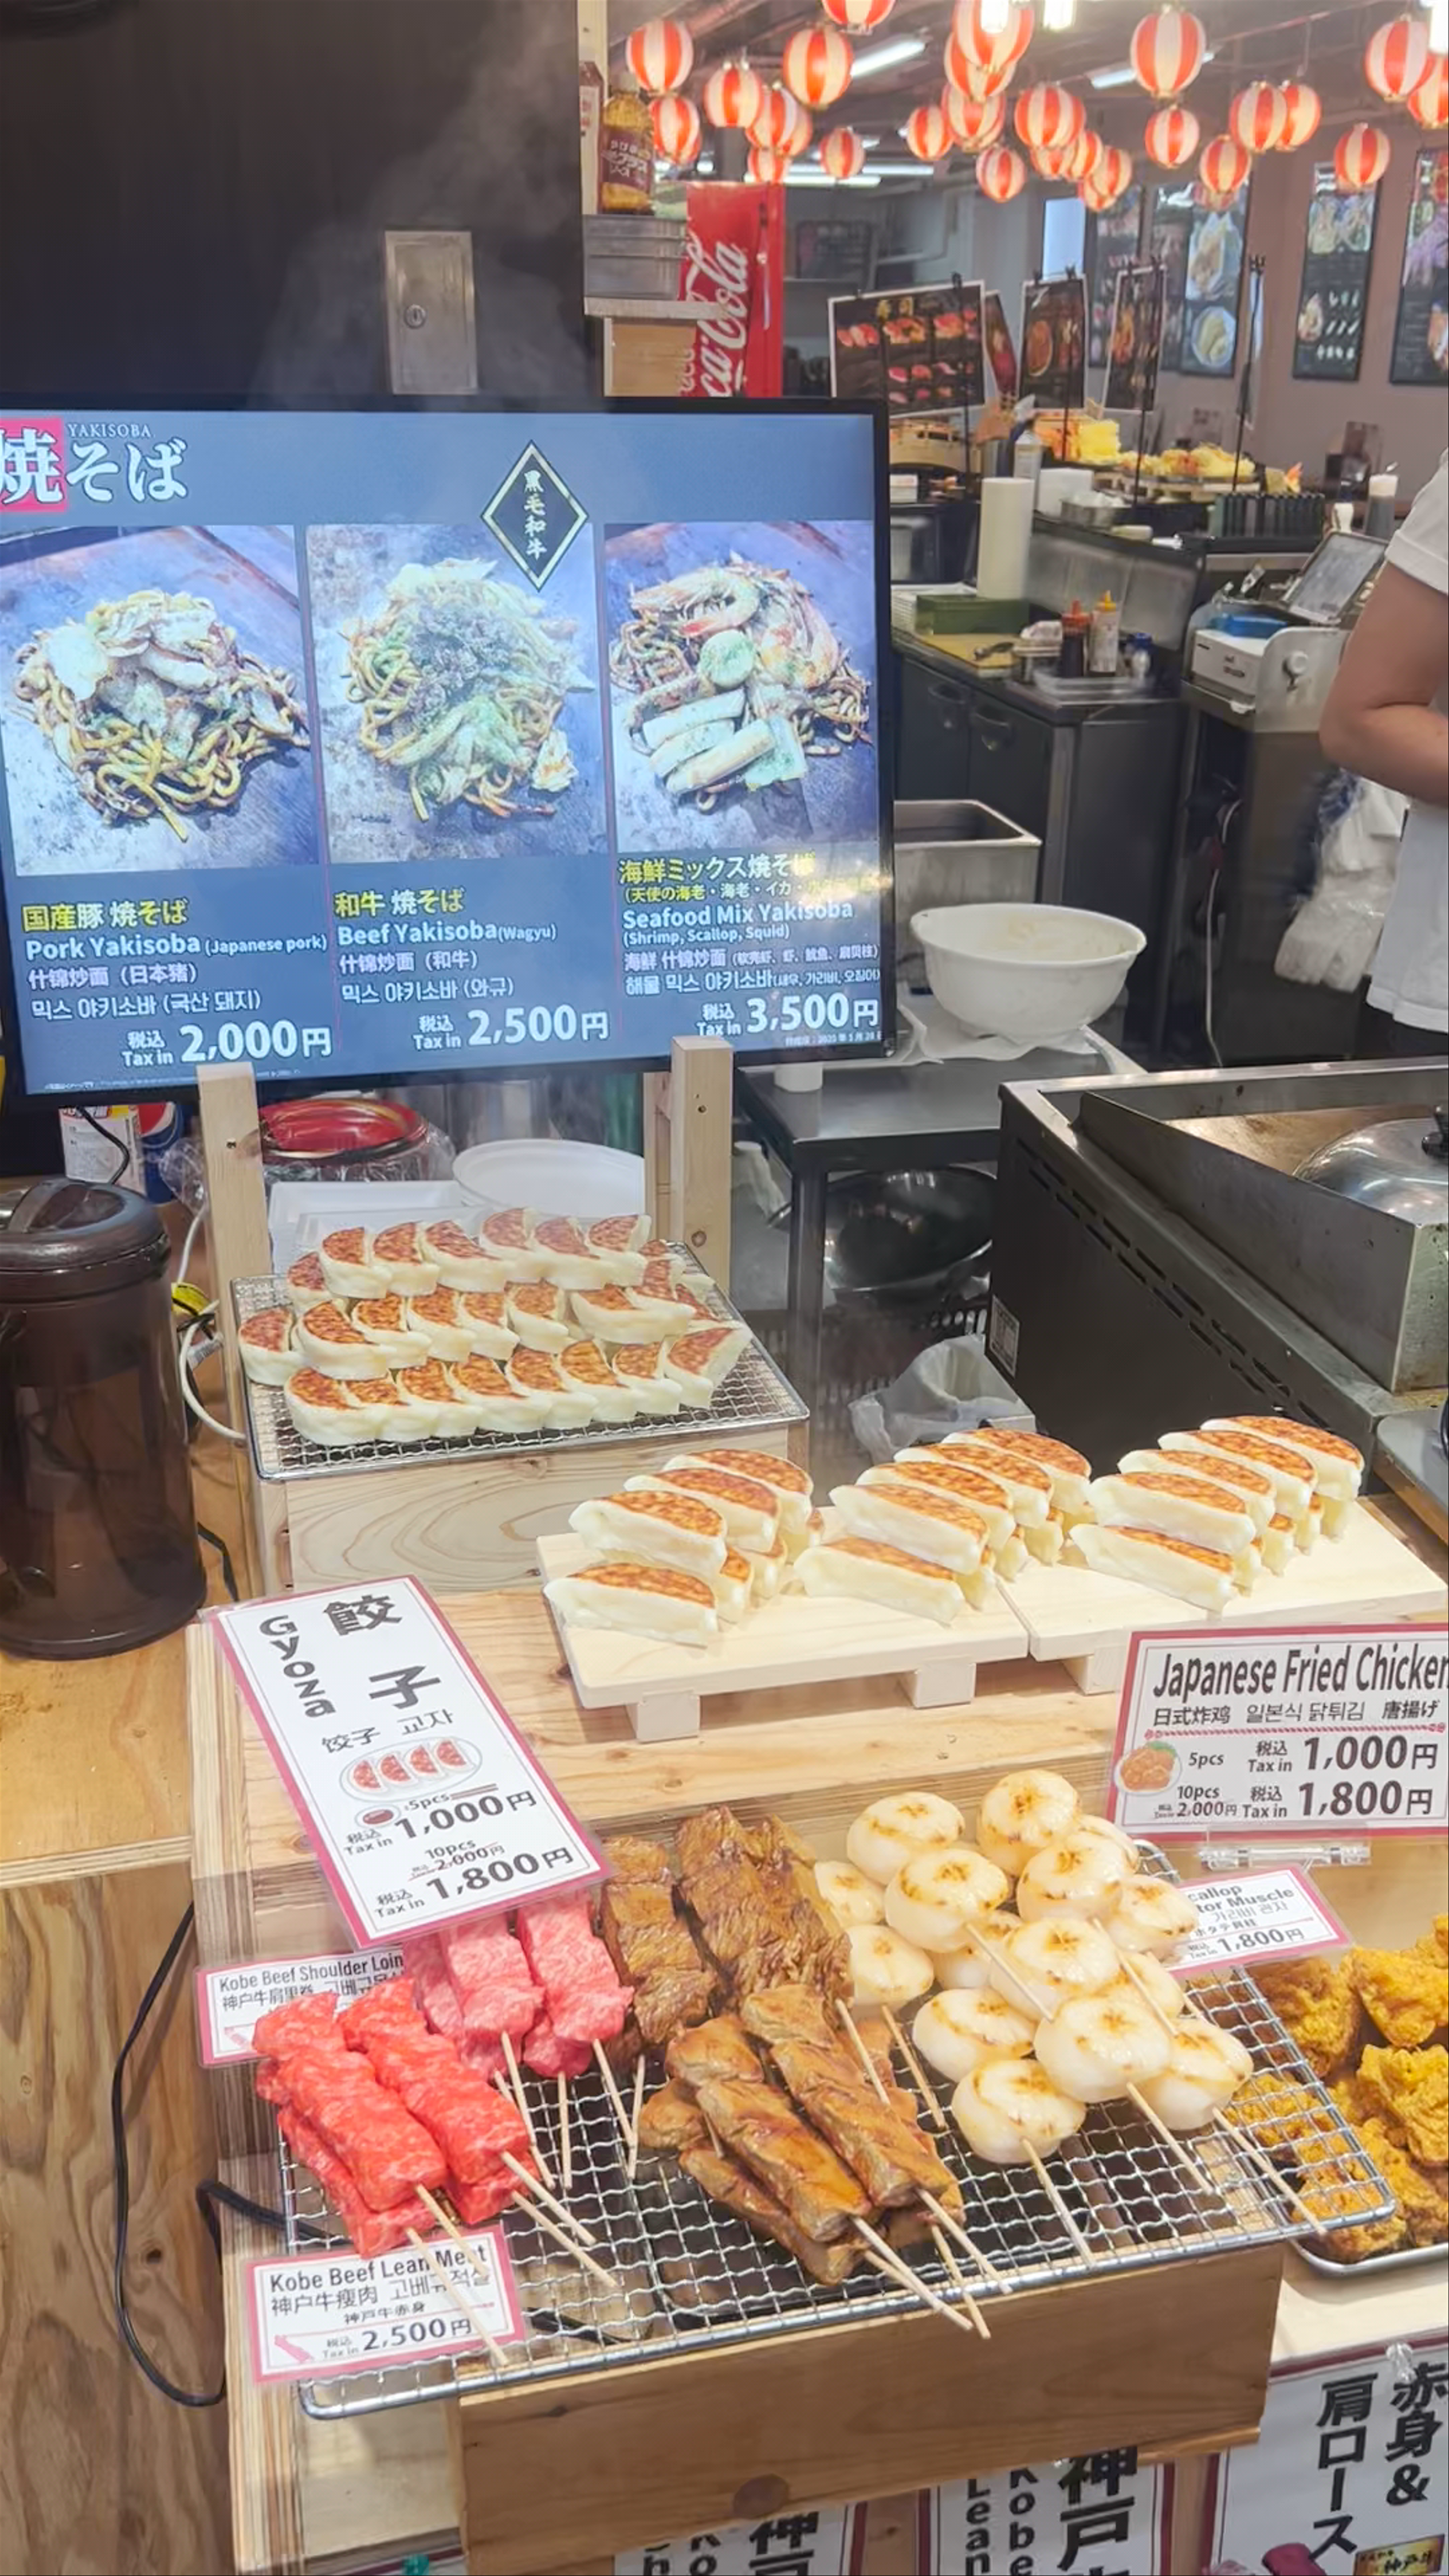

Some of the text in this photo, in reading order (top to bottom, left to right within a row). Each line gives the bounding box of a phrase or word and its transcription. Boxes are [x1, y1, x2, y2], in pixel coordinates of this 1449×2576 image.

[68, 423, 151, 438] YAKISOBA
[0, 426, 188, 504] 焼そば
[524, 470, 548, 561] 黒毛和牛
[334, 887, 465, 917] 和牛 焼そば
[22, 897, 189, 932] 国産豚 焼そば
[622, 901, 854, 929] Seafood Mix Yakisoba
[337, 924, 389, 946] Beef
[623, 924, 790, 947] (Shrimp, Scallop, Squid)
[26, 933, 328, 961] Pork Yakisoba (Japanese pork)
[342, 977, 515, 1004] 믹스 야키소바 (와규)
[625, 975, 660, 996] 해물
[666, 973, 701, 993] 믹스
[31, 990, 262, 1020] 믹스 야키소바 (국산 돼지)
[702, 1003, 735, 1021] 税込
[746, 992, 879, 1034] 3,500円
[418, 1015, 454, 1033] 税込
[467, 1004, 609, 1046] 2,500円
[696, 1021, 741, 1036] Tax in
[128, 1030, 165, 1049] 税込
[179, 1020, 332, 1063] 2,000円
[412, 1032, 461, 1050] Tax in
[121, 1049, 174, 1067] Tax in
[323, 1595, 441, 1710] 餃子
[259, 1615, 336, 1718] Gyoza
[1153, 1653, 1277, 1703] Japanese
[1282, 1644, 1352, 1693] Fried
[1153, 1707, 1231, 1727] 日式炸鸡
[1247, 1701, 1365, 1724] 일본식 닭튀김
[1381, 1699, 1440, 1719] 唐揚げ
[397, 1708, 454, 1735] 교자
[321, 1727, 380, 1754] 饺子
[1255, 1740, 1288, 1757] 税込
[1188, 1752, 1224, 1768] 5pcs
[1304, 1735, 1438, 1771] 1,000円
[1248, 1757, 1292, 1773] Tax in
[409, 1793, 450, 1810] 5pcs
[1177, 1785, 1220, 1801] 10pcs
[1250, 1785, 1283, 1802] 税込
[1298, 1781, 1433, 1816] 1,800円
[394, 1790, 537, 1839] 1,000円
[1242, 1803, 1287, 1818] Tax in
[346, 1836, 393, 1856] Tax in
[425, 1839, 477, 1859] 10pcs
[426, 1847, 574, 1901] 1,800円
[377, 1889, 414, 1906] 税込
[1188, 1885, 1242, 1902] callop
[1226, 1889, 1294, 1907] Muscle
[374, 1898, 425, 1918] Tax in
[1217, 1928, 1304, 1952] 1,800円
[219, 1952, 404, 1993] Kobe Beef Shoulder Loin
[270, 2245, 487, 2293] Kobe Beef Lean Met
[362, 2318, 472, 2351] 2,500円
[1309, 2372, 1378, 2560] 肩ロース
[1058, 2446, 1135, 2576] 神戸
